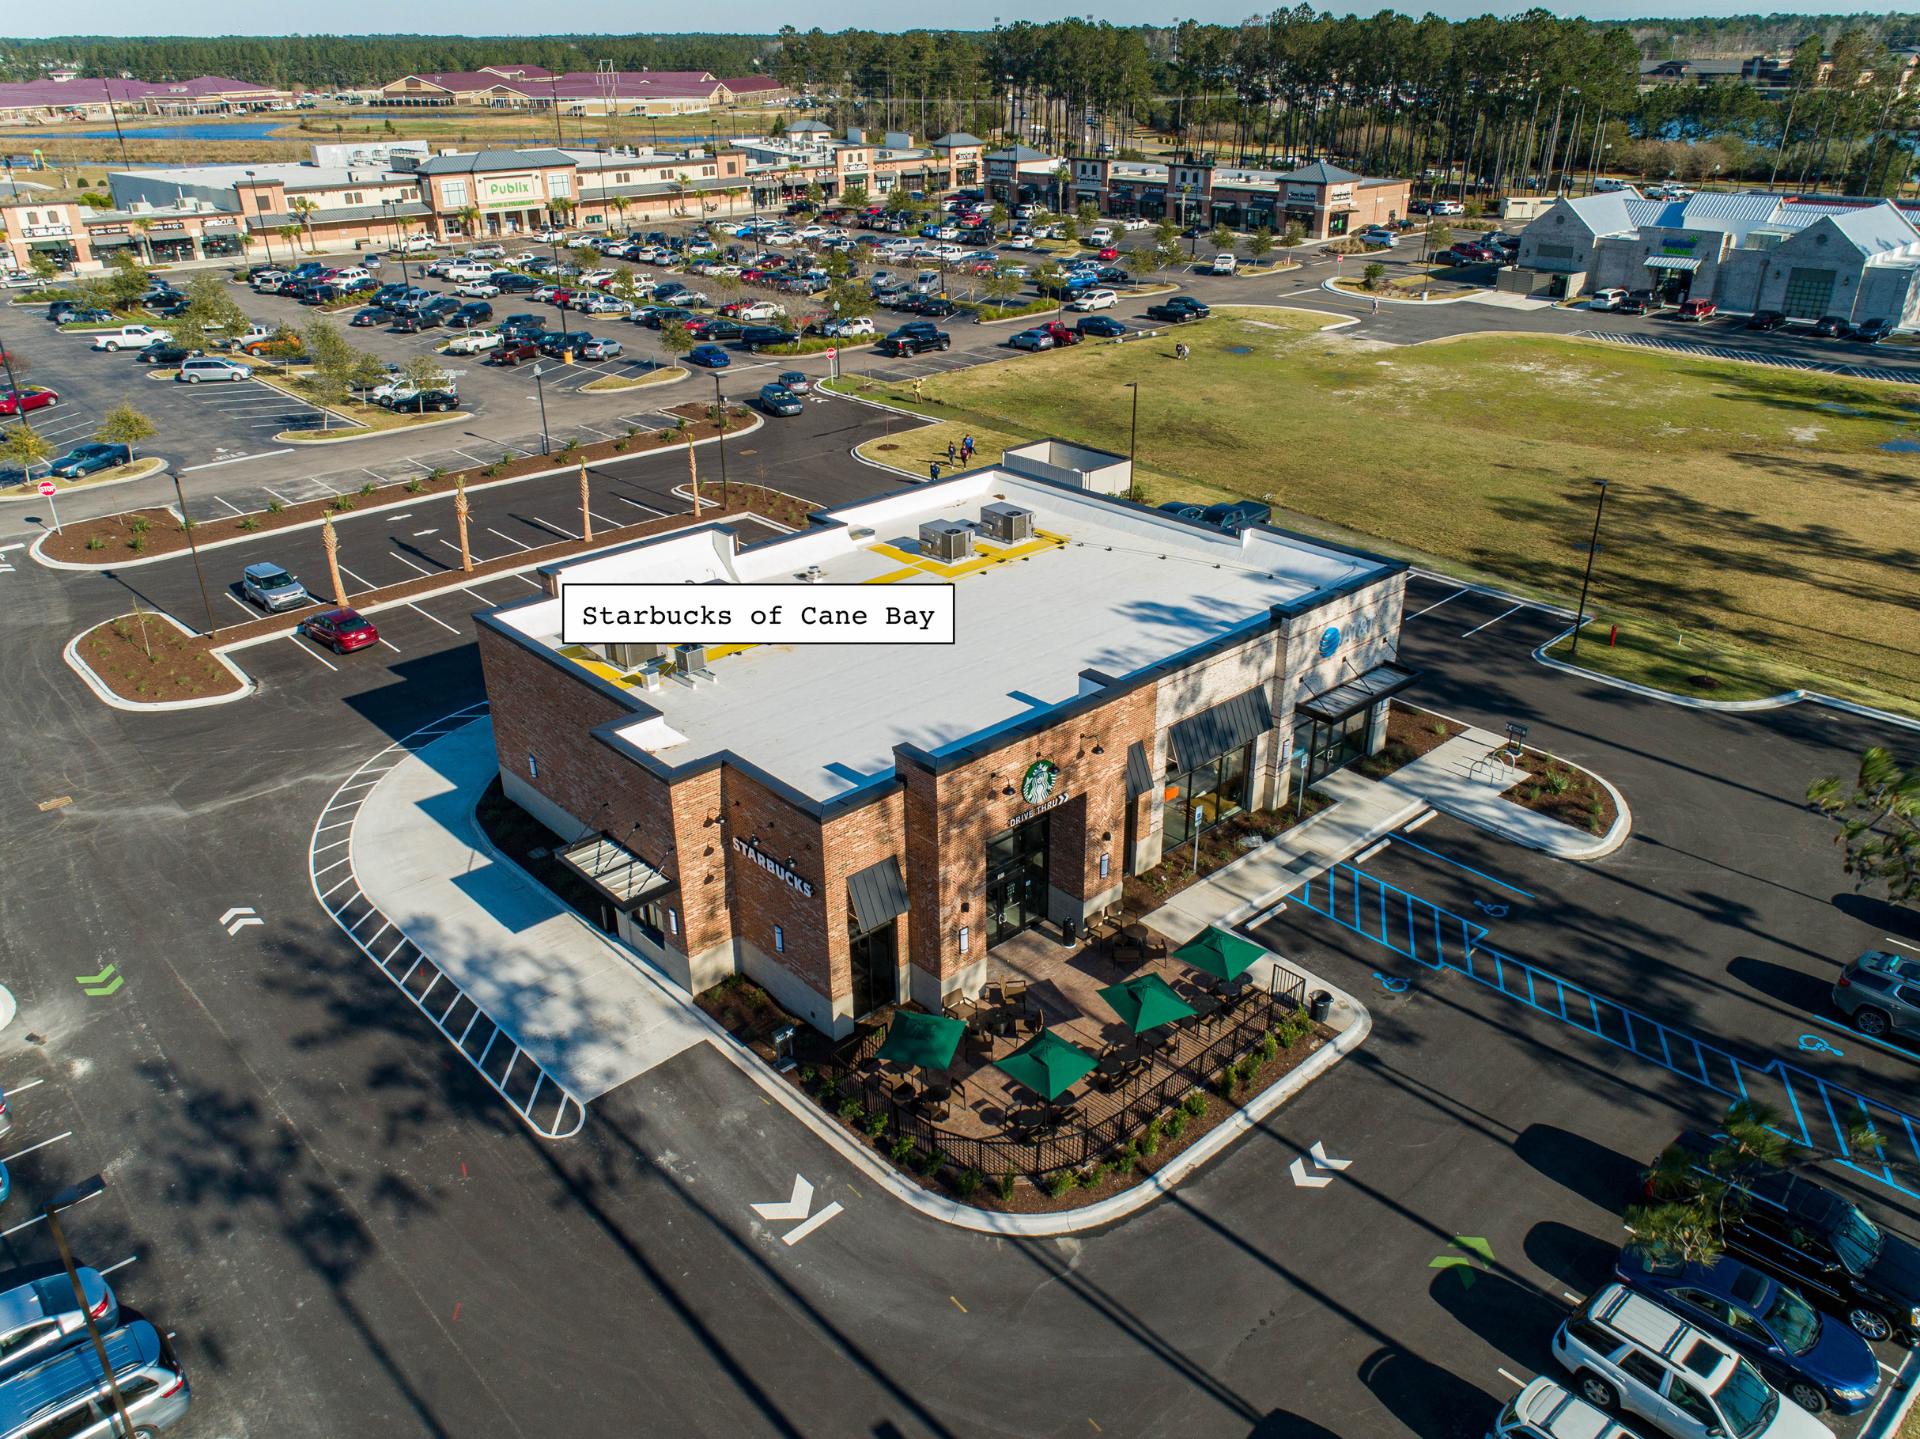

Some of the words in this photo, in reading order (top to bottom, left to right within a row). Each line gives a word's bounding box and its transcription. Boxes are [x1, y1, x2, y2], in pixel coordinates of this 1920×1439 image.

[491, 181, 529, 195] Publix
[40, 485, 55, 493] STOP
[1009, 809, 1034, 827] DRIVE
[1036, 798, 1058, 815] THRU
[732, 837, 812, 898] STARBUCKS
